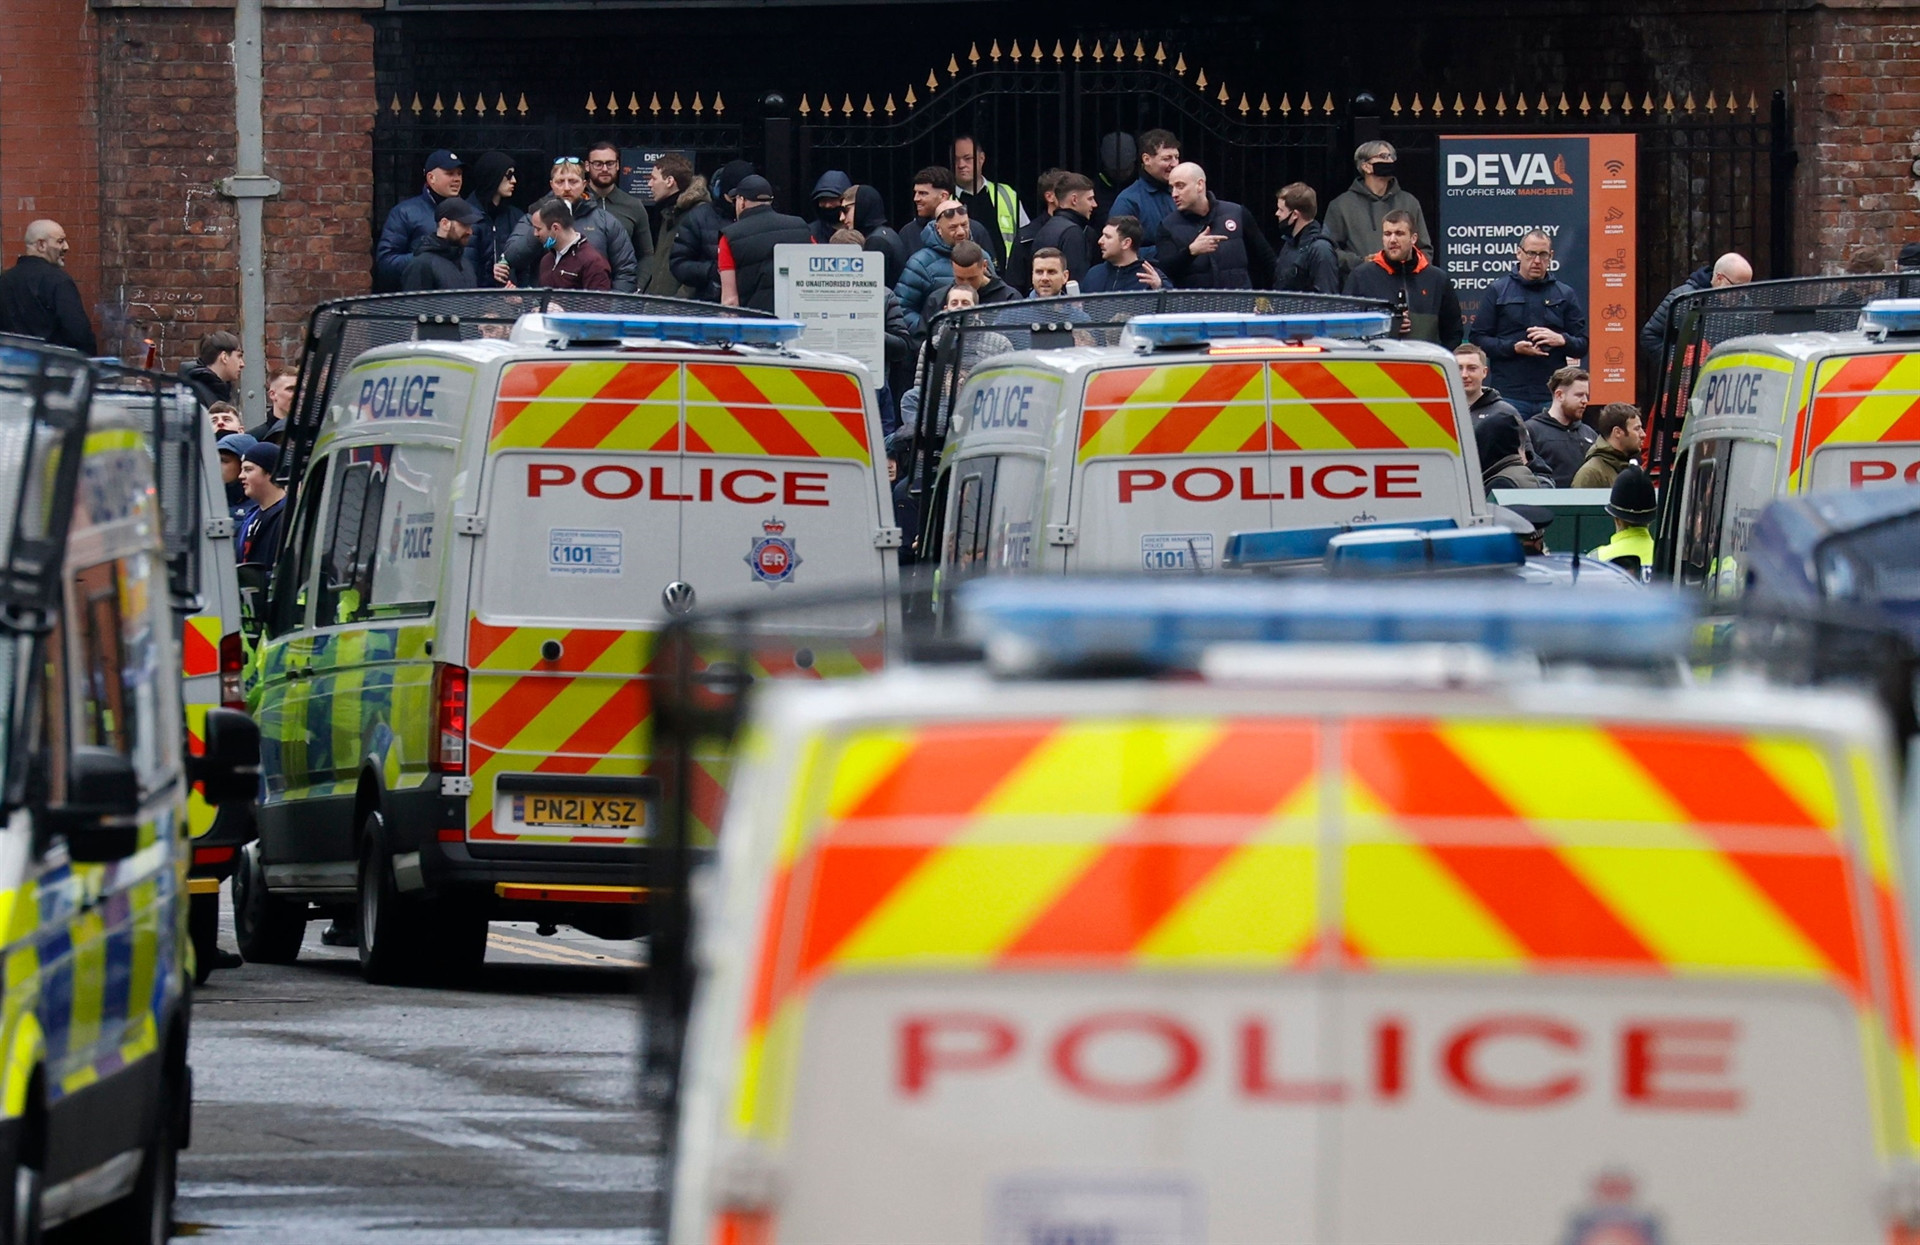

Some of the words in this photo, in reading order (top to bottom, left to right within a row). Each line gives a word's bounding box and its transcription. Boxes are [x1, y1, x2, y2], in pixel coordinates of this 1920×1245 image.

[644, 153, 666, 162] DEV
[1447, 154, 1555, 186] DEVA
[1447, 188, 1465, 196] CITY
[1466, 188, 1495, 196] OFFICE
[1496, 188, 1516, 196] PARK
[1517, 187, 1574, 196] MANCHESTER
[1447, 225, 1560, 238] CONTEMPORRY
[1447, 243, 1482, 255] HIGH
[1484, 243, 1519, 255] QUAL
[810, 257, 864, 272] UKPC
[1447, 260, 1480, 272] SELF
[795, 280, 805, 288] NO
[805, 280, 851, 288] UNAUTHORISED
[852, 280, 878, 288] PARKING
[356, 375, 440, 420] POLICE
[1704, 373, 1763, 416] POLICE
[970, 385, 1034, 431] POLICE
[527, 463, 830, 507] POLICE
[1118, 464, 1422, 504] POLICE
[563, 546, 593, 563] 101
[1155, 550, 1185, 568] 101
[533, 798, 585, 821] PN21
[592, 800, 636, 823] XSZ
[894, 1010, 1744, 1114] POLICE
